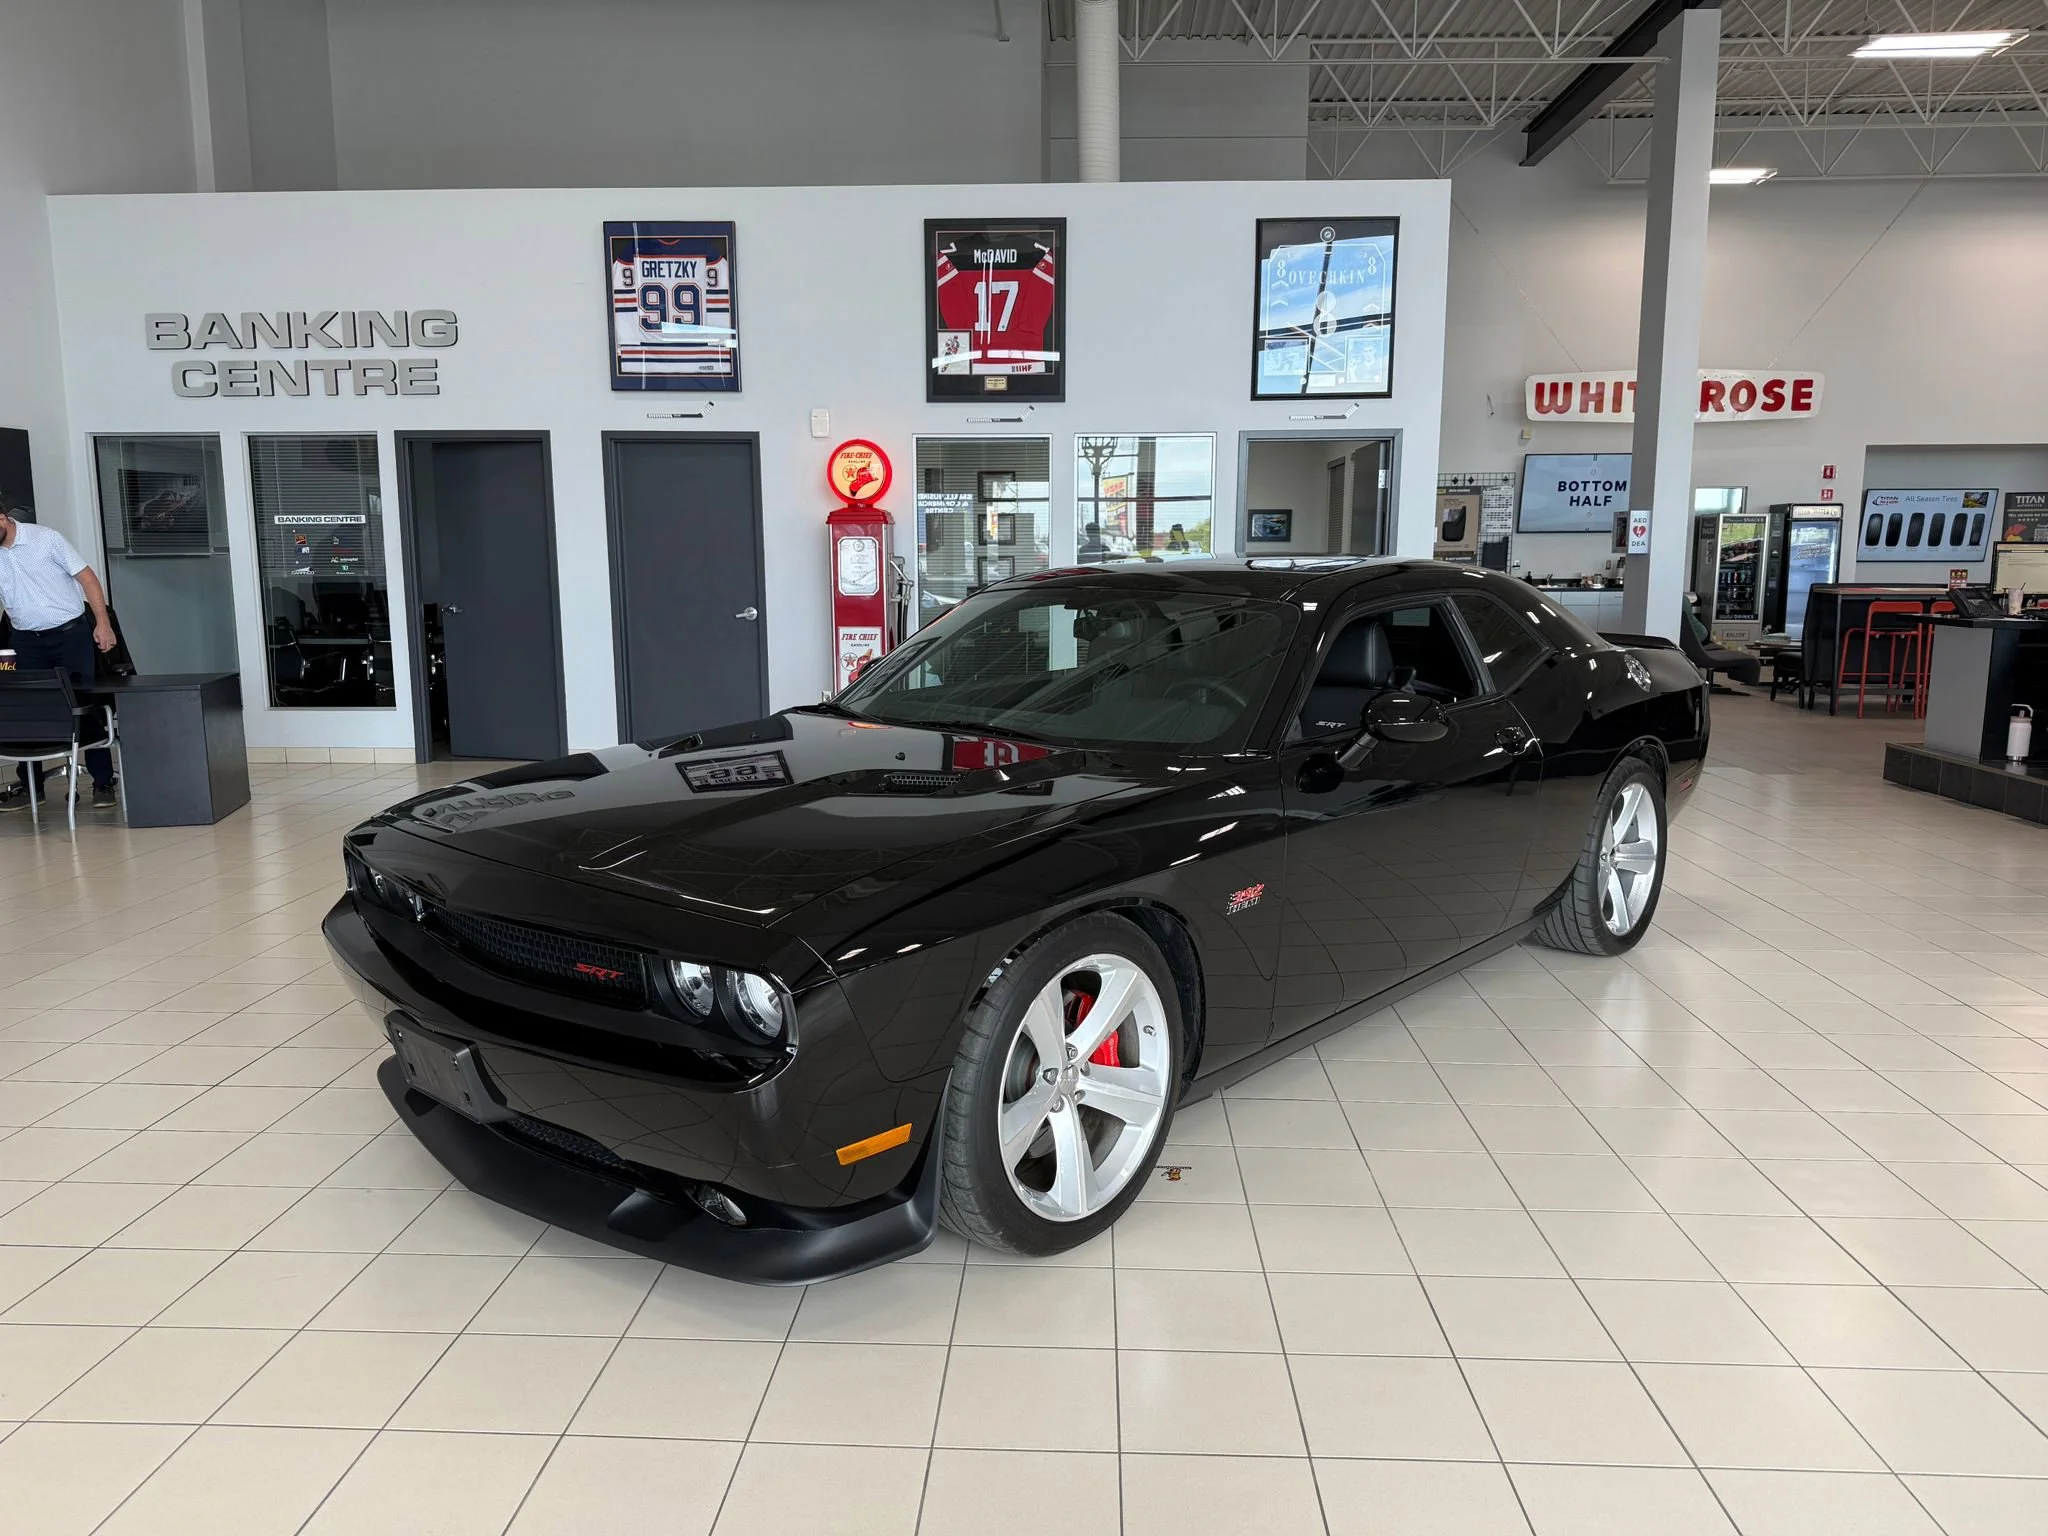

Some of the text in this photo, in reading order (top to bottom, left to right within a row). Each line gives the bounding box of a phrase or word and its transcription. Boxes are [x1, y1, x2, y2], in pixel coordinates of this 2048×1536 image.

[974, 249, 1018, 264] McDAVID
[1368, 257, 1377, 275] 8
[622, 268, 634, 287] 9
[642, 261, 697, 278] GRETZKY
[706, 268, 718, 287] 9
[1277, 260, 1286, 277] 8
[1288, 270, 1366, 285] OVECHKIN
[638, 282, 703, 333] 99
[974, 281, 1019, 331] 17
[145, 310, 458, 350] BANKING
[171, 359, 440, 397] CENTRE
[1699, 379, 1814, 413] ROSE
[1557, 481, 1627, 492] BOTTOM
[1569, 496, 1612, 506] HALF
[573, 962, 625, 981] SRT
